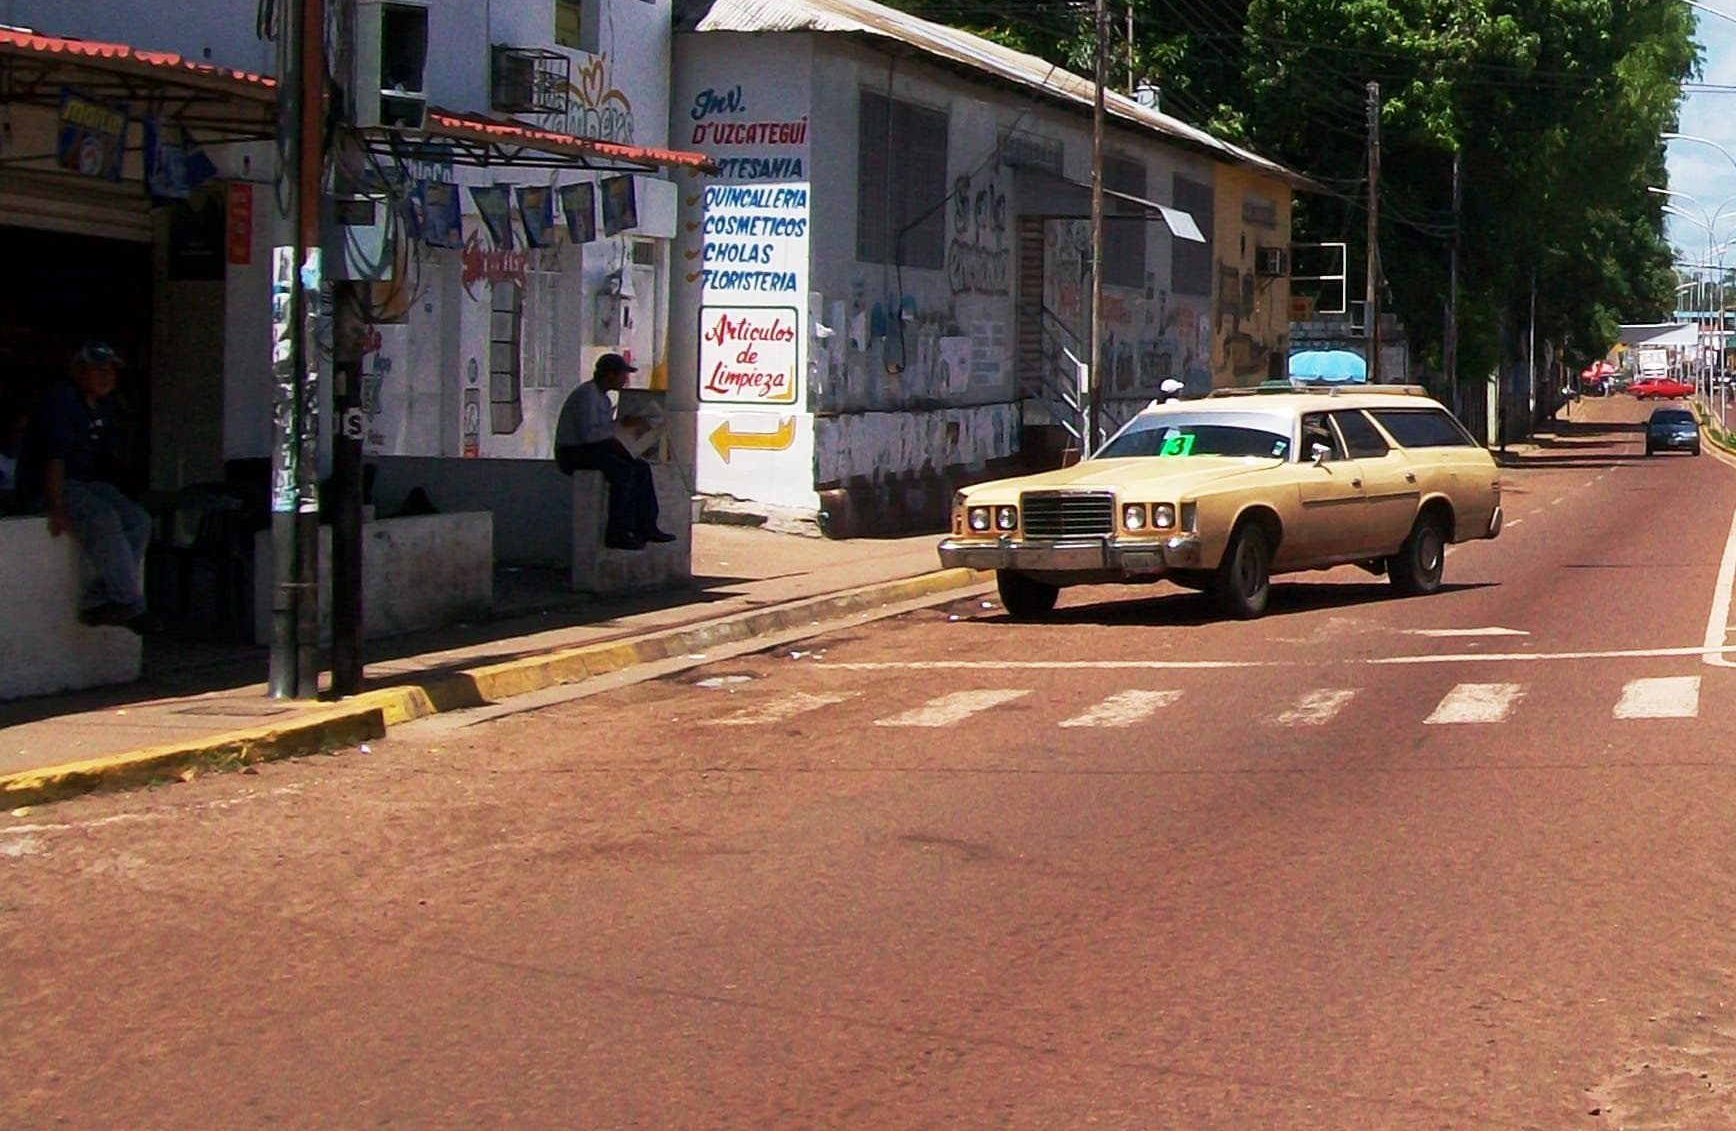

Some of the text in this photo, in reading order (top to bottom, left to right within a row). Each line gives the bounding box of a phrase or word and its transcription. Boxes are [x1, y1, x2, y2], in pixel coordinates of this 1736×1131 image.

[704, 185, 807, 211] QUINCALLERIA
[703, 215, 807, 238] COSMETICOS
[703, 243, 774, 264] CHOLAS
[701, 269, 798, 293] FLORISTERIA
[736, 344, 759, 364] de
[705, 367, 785, 397] Limpieza
[1168, 436, 1185, 455] 3
